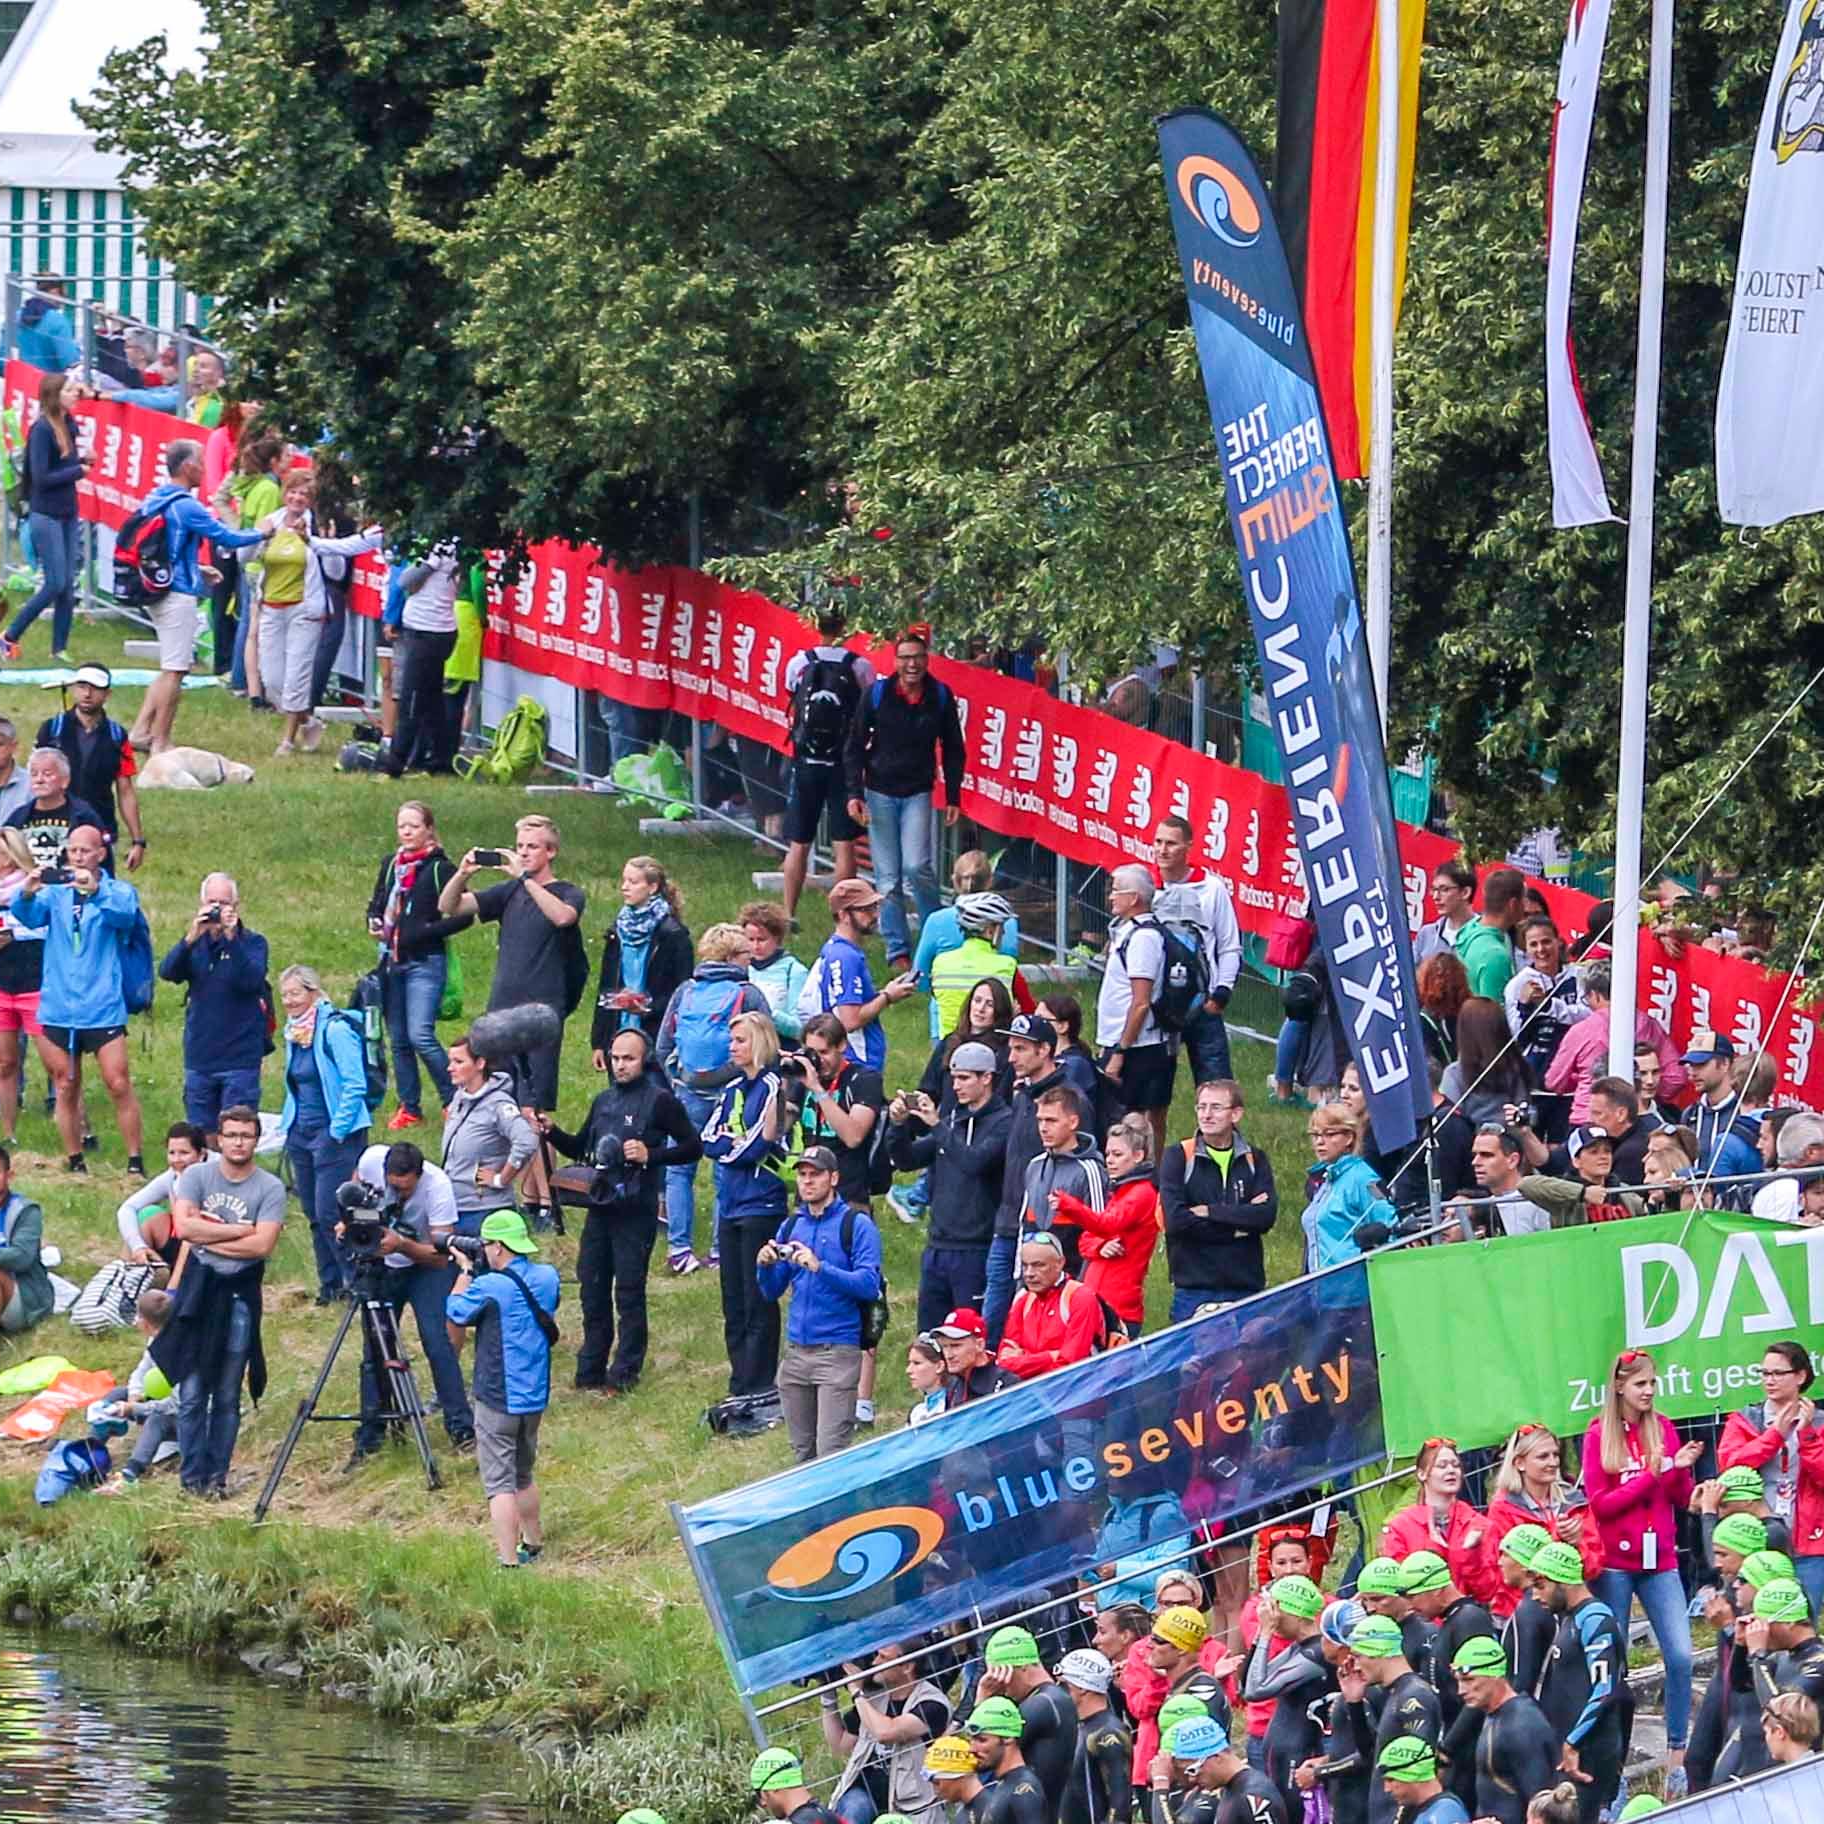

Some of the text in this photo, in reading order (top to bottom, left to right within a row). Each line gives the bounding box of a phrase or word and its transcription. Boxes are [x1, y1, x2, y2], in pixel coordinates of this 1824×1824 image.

[1567, 1369, 1691, 1413] Zunft
[955, 1351, 1354, 1534] blueseventy
[1069, 1653, 1106, 1674] DATEV
[1180, 1725, 1216, 1742] DATEV
